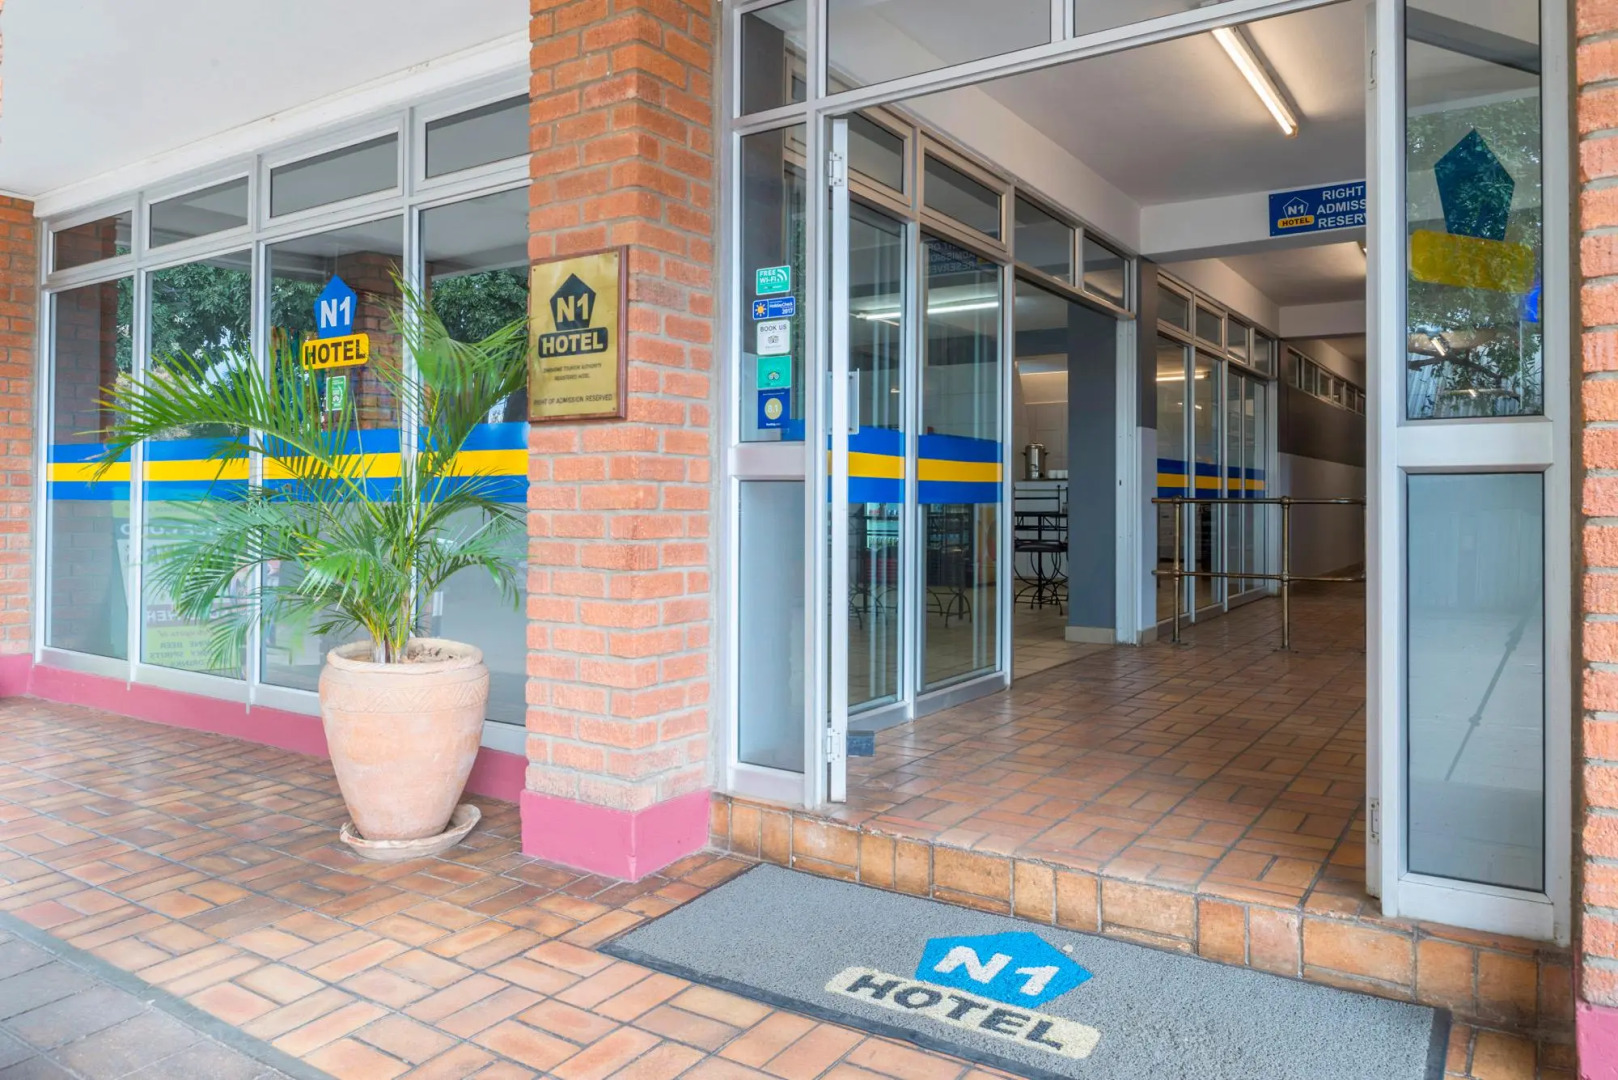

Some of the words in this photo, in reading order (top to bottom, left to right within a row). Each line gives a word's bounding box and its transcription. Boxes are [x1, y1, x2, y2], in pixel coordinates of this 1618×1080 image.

[1322, 185, 1364, 201] RIGHT
[1287, 204, 1304, 215] N1
[1282, 217, 1311, 227] HOTEL
[1318, 213, 1366, 229] RESER
[760, 269, 776, 277] FREE
[320, 296, 350, 328] N1
[557, 292, 589, 323] N1
[760, 324, 777, 332] BOOK
[779, 323, 787, 331] US
[542, 330, 604, 355] HOTEL
[304, 339, 366, 366] HOTEL
[556, 396, 583, 404] ADMISSION
[585, 393, 612, 402] RESERVED
[933, 945, 1060, 996] N1
[845, 974, 1063, 1051] HOTEL
